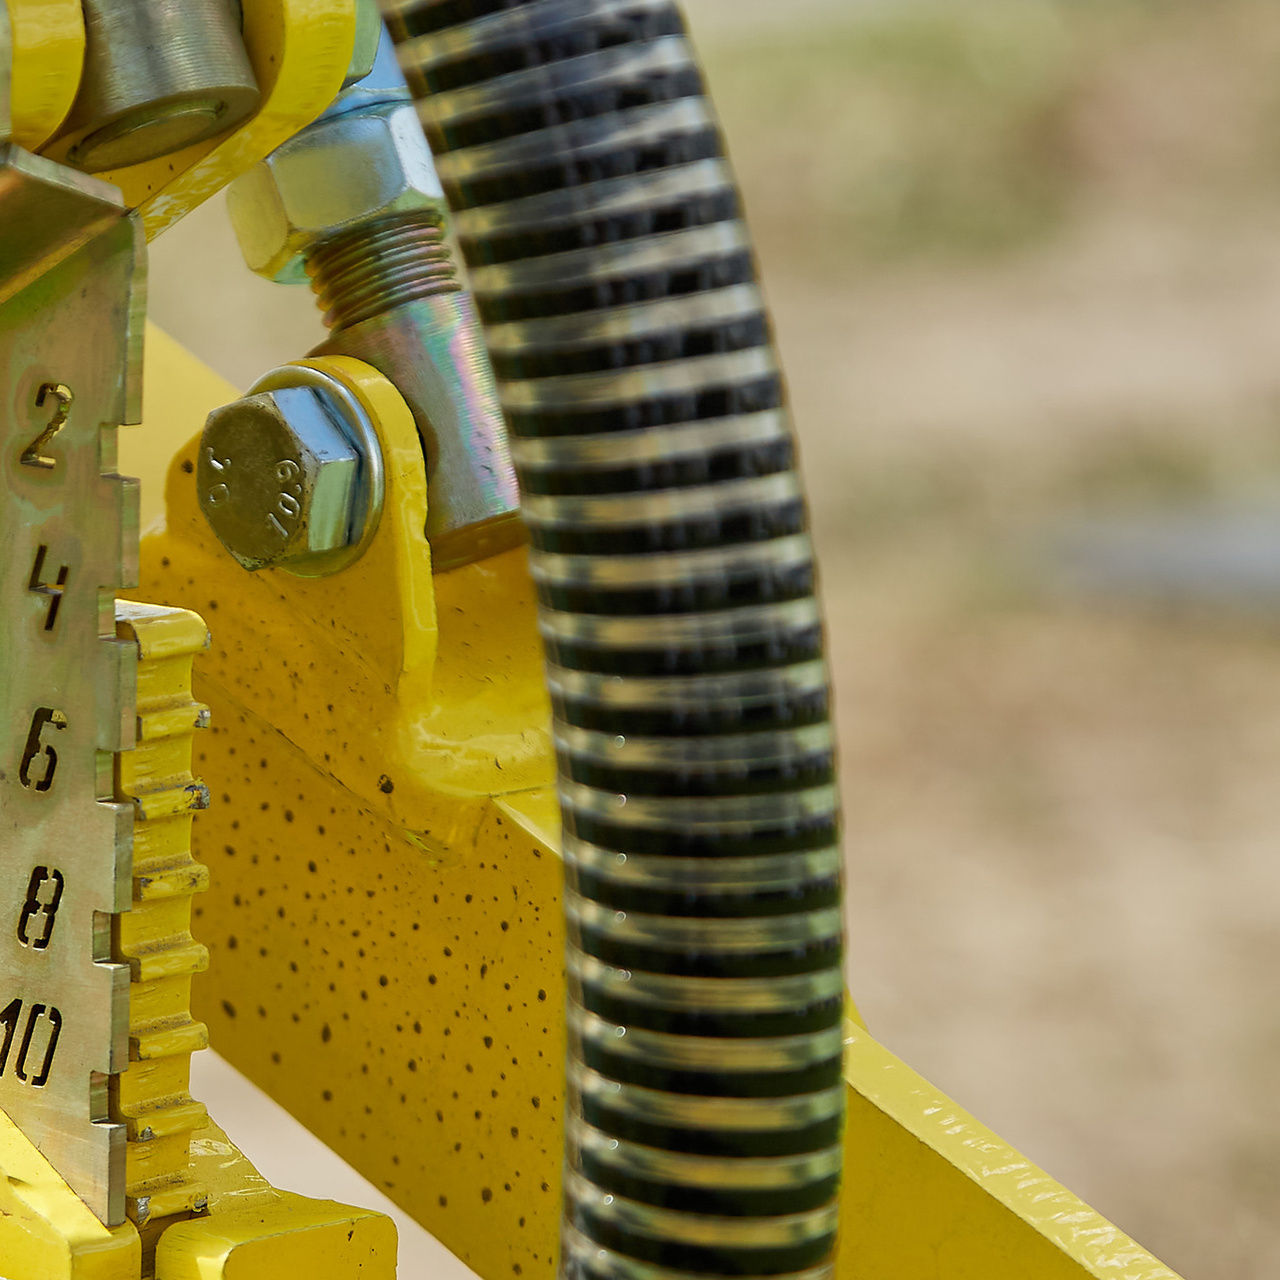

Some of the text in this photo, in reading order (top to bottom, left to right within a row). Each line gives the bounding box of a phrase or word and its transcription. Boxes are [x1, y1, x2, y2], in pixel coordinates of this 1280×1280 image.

[21, 383, 75, 469] 2
[28, 544, 68, 631] 4
[19, 706, 67, 793] 6
[17, 865, 64, 950] 8
